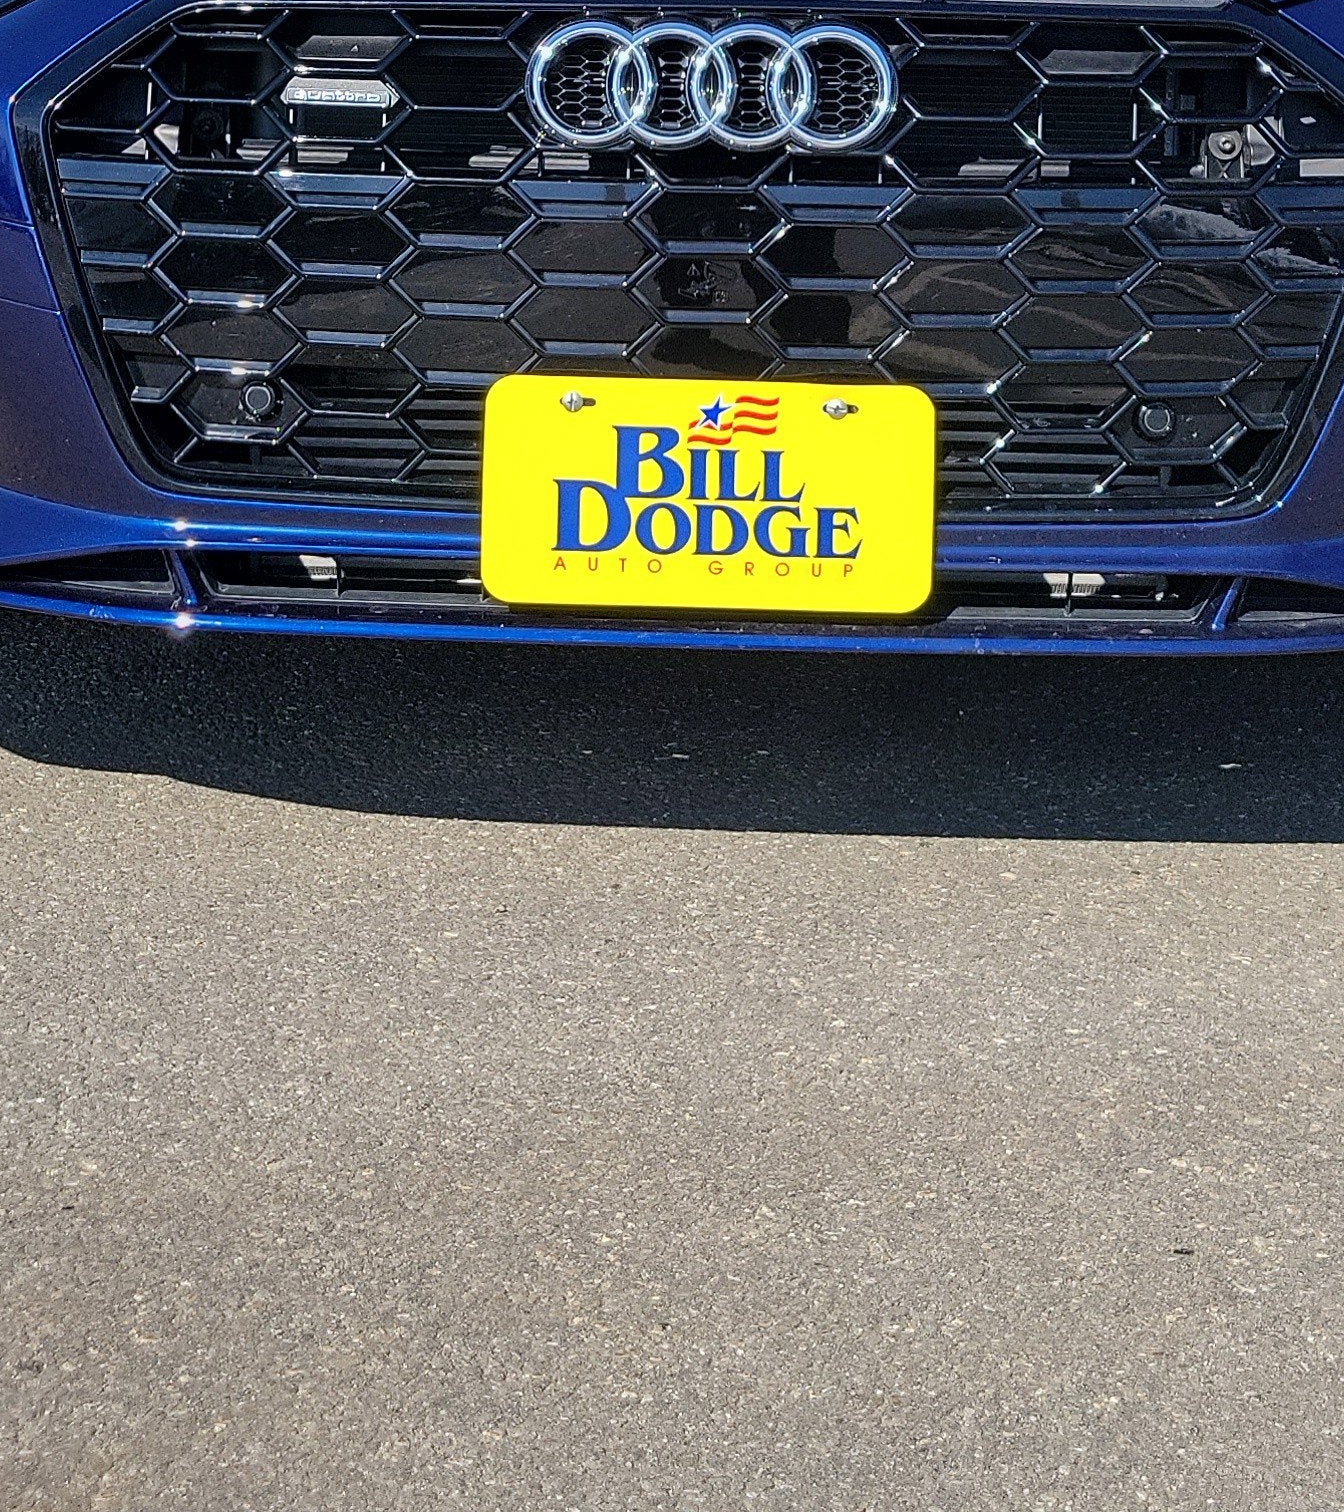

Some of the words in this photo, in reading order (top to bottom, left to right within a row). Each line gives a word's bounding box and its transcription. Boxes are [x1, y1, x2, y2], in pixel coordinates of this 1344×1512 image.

[294, 87, 381, 102] quattro
[612, 424, 806, 502] BILL
[551, 478, 863, 559] DODGE
[554, 555, 663, 574] AUTO
[708, 560, 855, 578] GROUP
